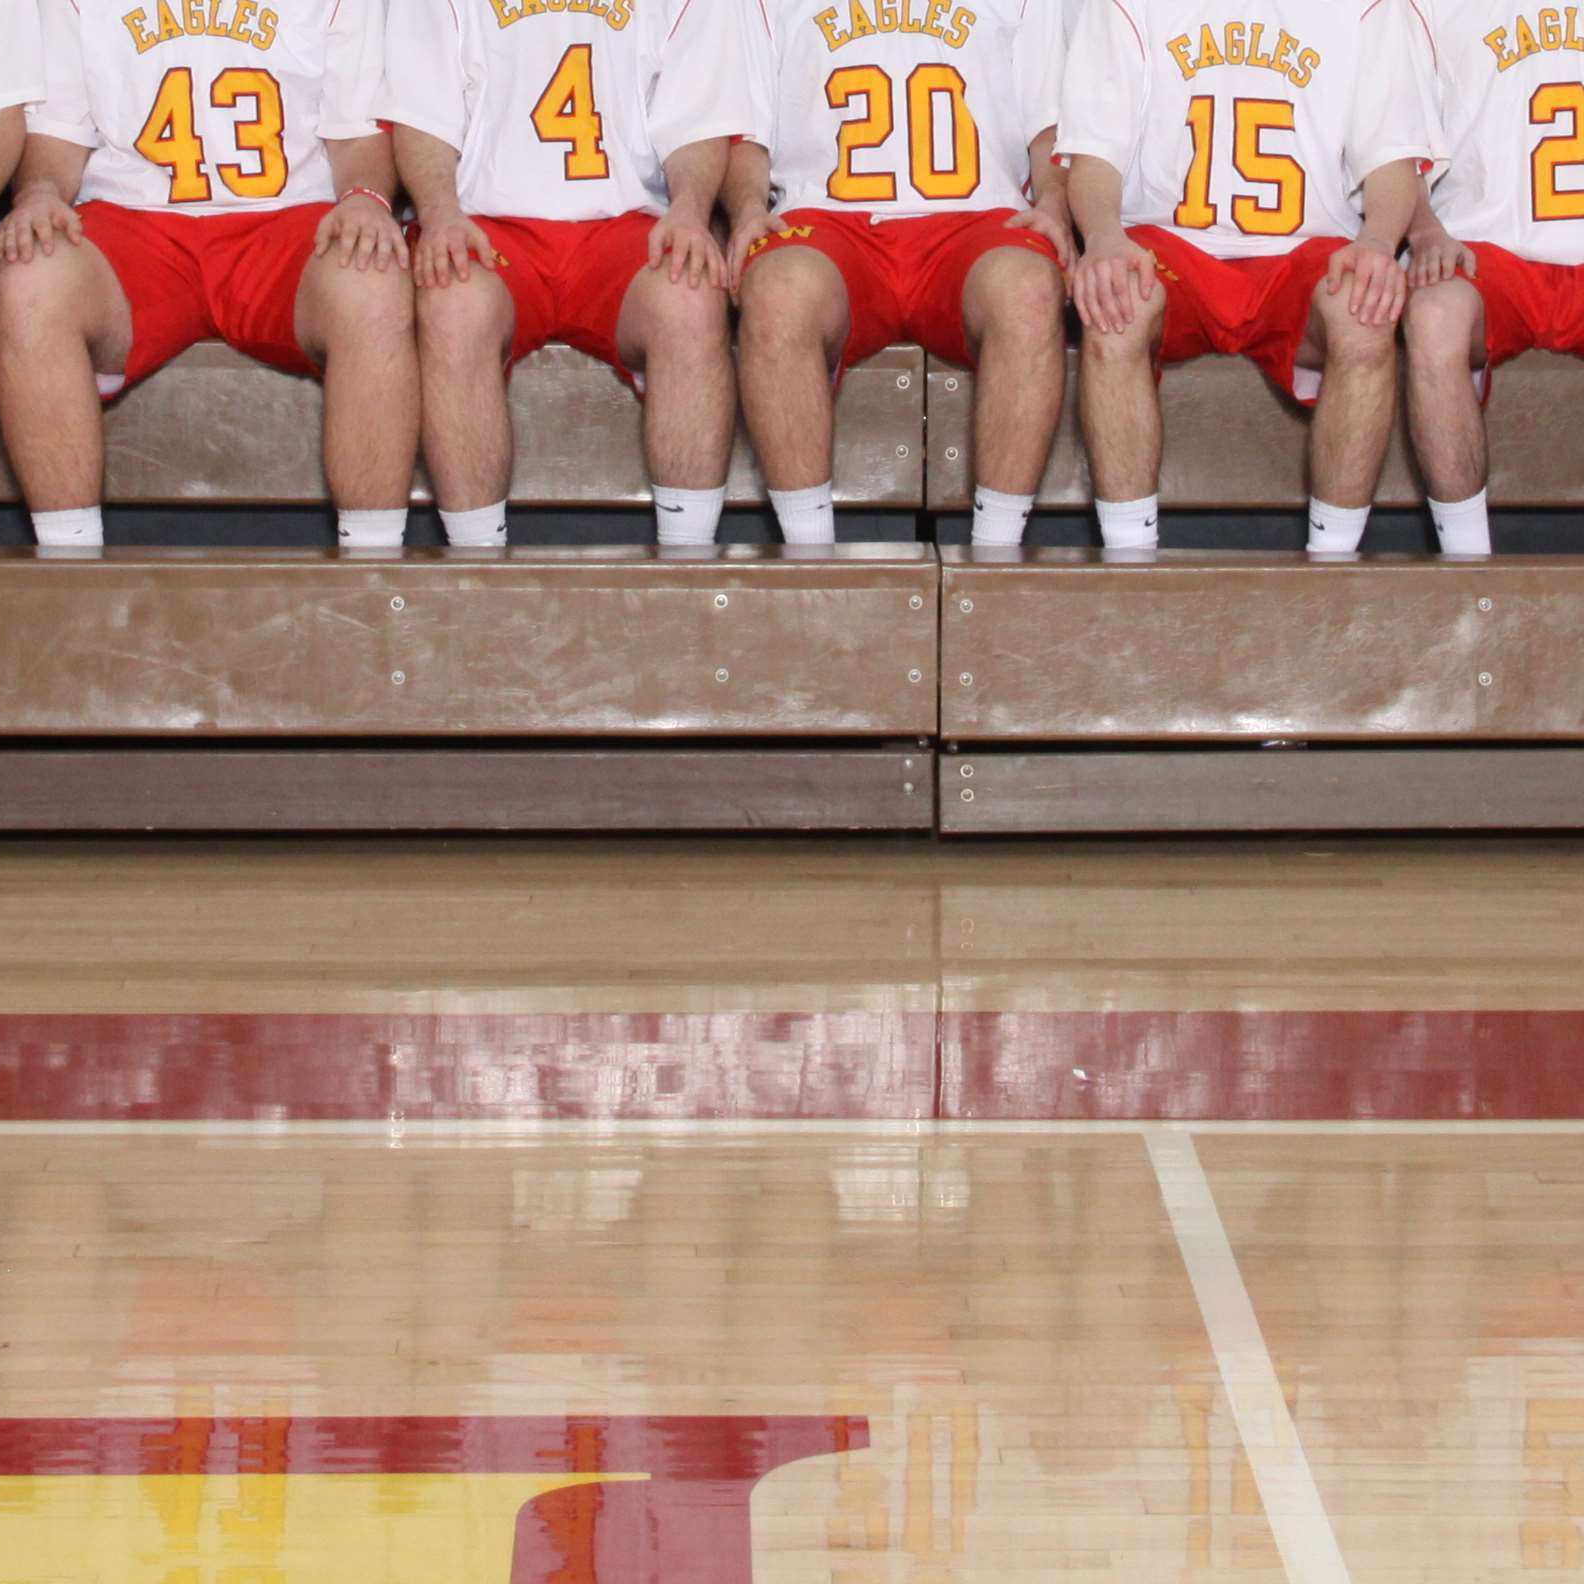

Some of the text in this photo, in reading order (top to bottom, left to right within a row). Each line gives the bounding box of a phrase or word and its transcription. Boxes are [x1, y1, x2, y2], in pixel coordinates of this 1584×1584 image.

[530, 44, 610, 181] 4
[1167, 20, 1321, 89] EAGLES
[134, 66, 289, 203] 43
[825, 64, 981, 202] 20
[1173, 95, 1306, 237] 15
